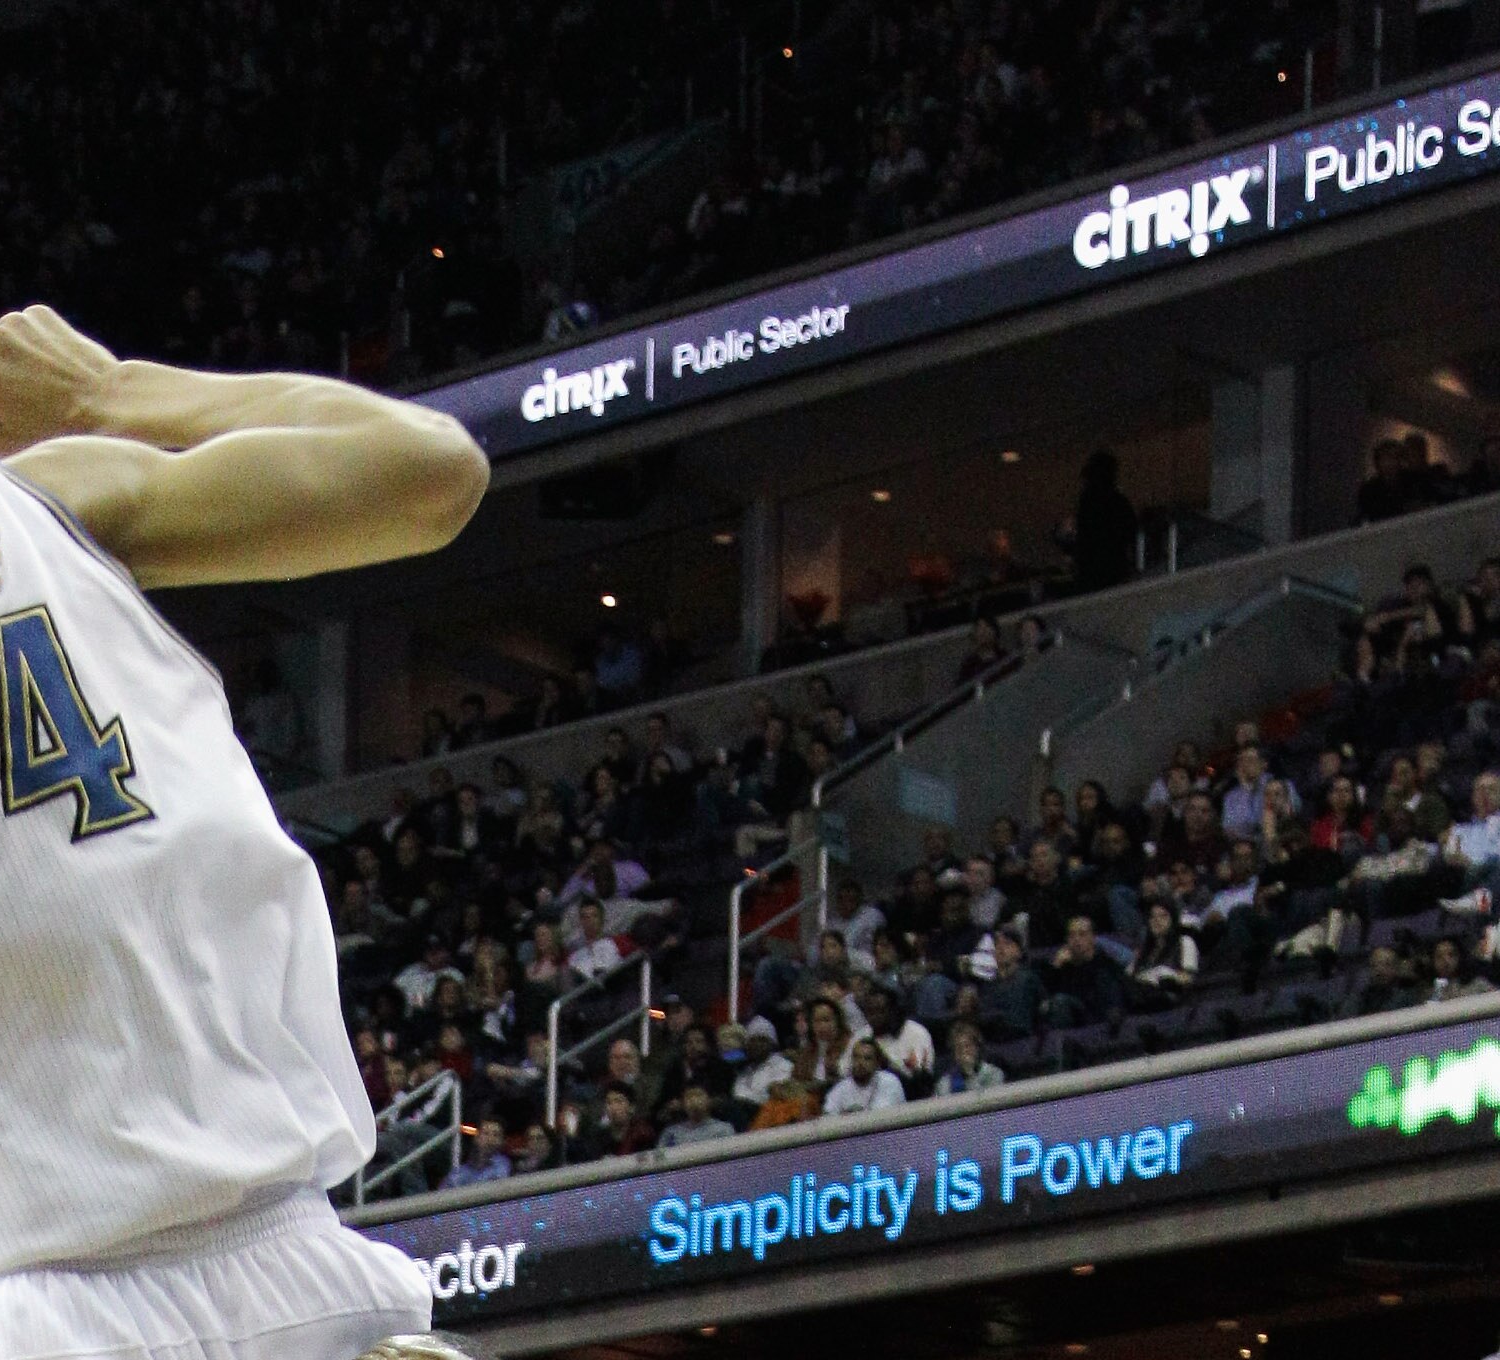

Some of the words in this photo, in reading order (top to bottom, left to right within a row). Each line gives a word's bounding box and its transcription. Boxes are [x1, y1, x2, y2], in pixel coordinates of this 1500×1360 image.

[1304, 121, 1445, 202] Public
[672, 328, 755, 378] Public
[759, 304, 850, 354] Sector
[411, 1238, 526, 1300] ctor
[649, 1164, 918, 1264] Simplicity
[935, 1149, 983, 1215] is
[1001, 1119, 1194, 1204] Power
